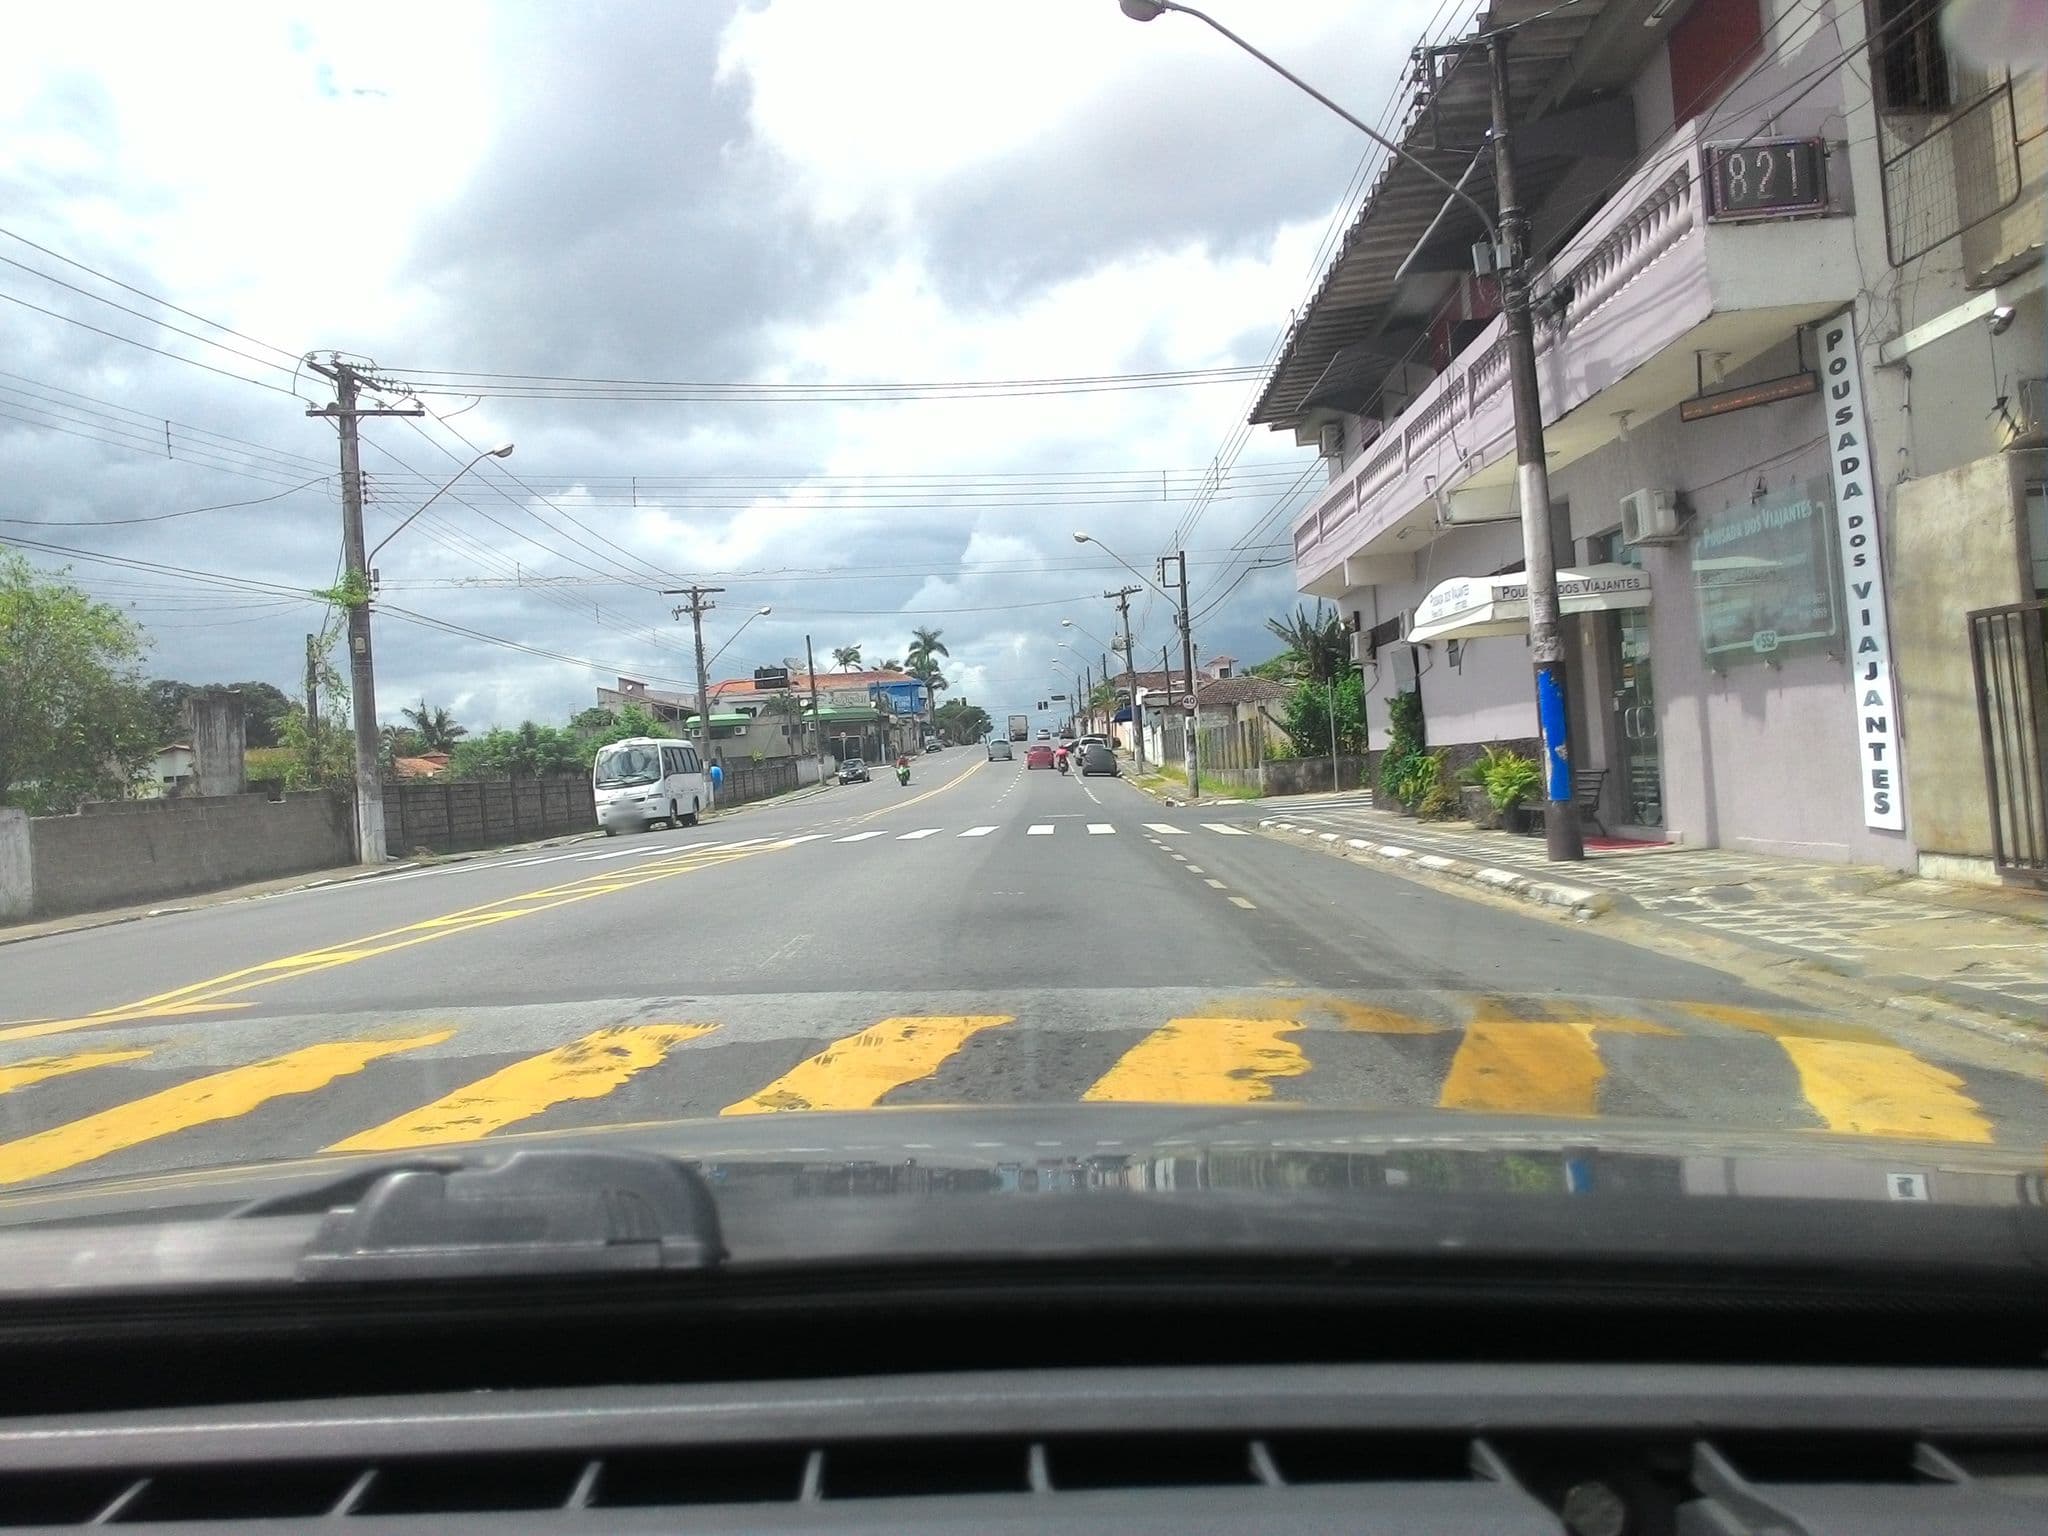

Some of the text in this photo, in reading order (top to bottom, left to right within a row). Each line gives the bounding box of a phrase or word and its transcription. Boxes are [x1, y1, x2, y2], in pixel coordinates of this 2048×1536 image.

[1728, 149, 1799, 201] 821
[1582, 578, 1640, 592] VIAJANTES
[1826, 328, 1890, 815] POUSADA DOS VIAJANTES
[1183, 696, 1195, 704] 40
